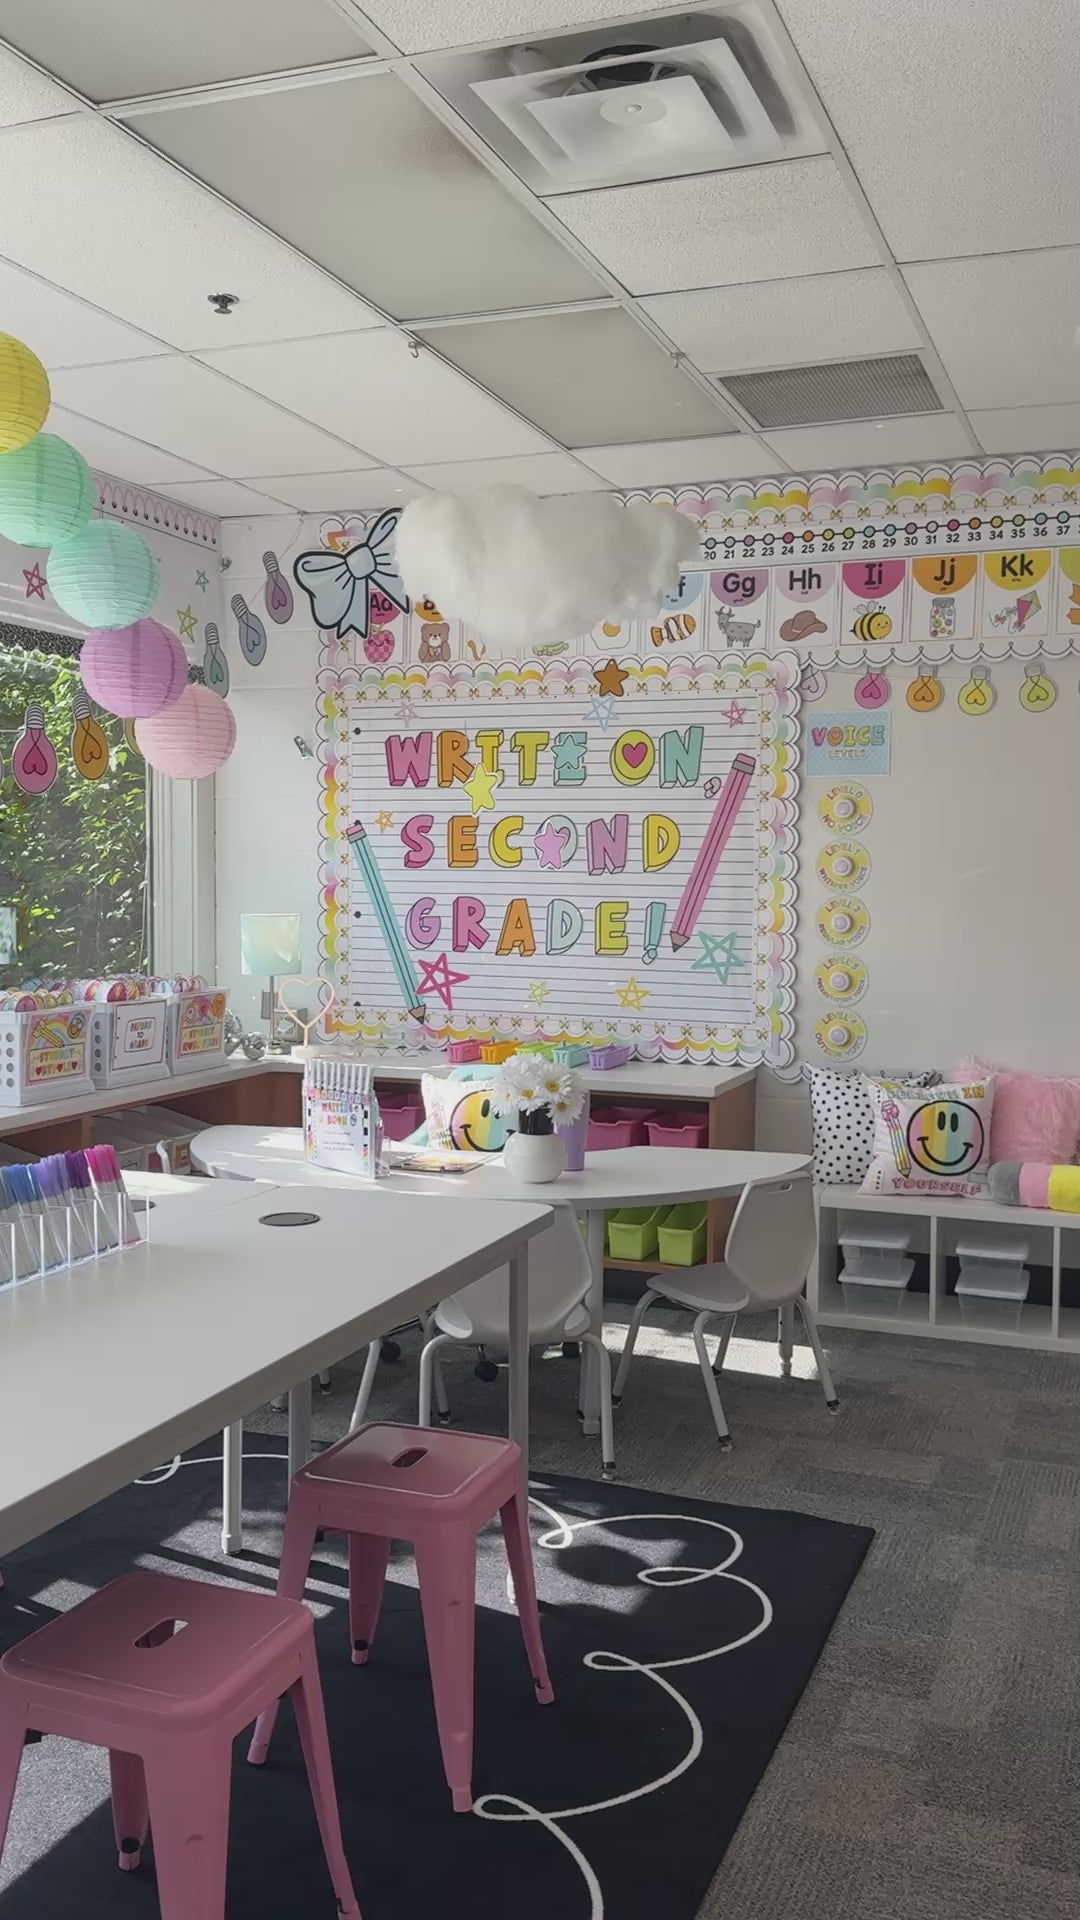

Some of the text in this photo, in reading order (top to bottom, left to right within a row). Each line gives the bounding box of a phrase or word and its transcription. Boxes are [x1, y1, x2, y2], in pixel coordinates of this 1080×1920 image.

[704, 525, 1070, 561] 20 21 22 23 24 25 26 27 28 29 30 31 32 33 34 35 36 37
[864, 562, 884, 586] Ii
[934, 557, 956, 586] Jj
[1000, 553, 1034, 578] Kk
[722, 572, 756, 598] Gg
[789, 567, 821, 591] Hh
[811, 725, 885, 747] VOICE
[827, 748, 867, 759] LEVELS
[826, 784, 854, 800] LEVEL
[822, 812, 869, 833] NO VOICE
[825, 842, 853, 857] LEVEL
[824, 898, 852, 913] LEVEL
[404, 896, 667, 965] GRADE!
[823, 956, 850, 970] LEVEL
[821, 1011, 849, 1025] LEVEL
[961, 1085, 985, 1099] IN
[892, 1177, 982, 1196] YOURSELF
